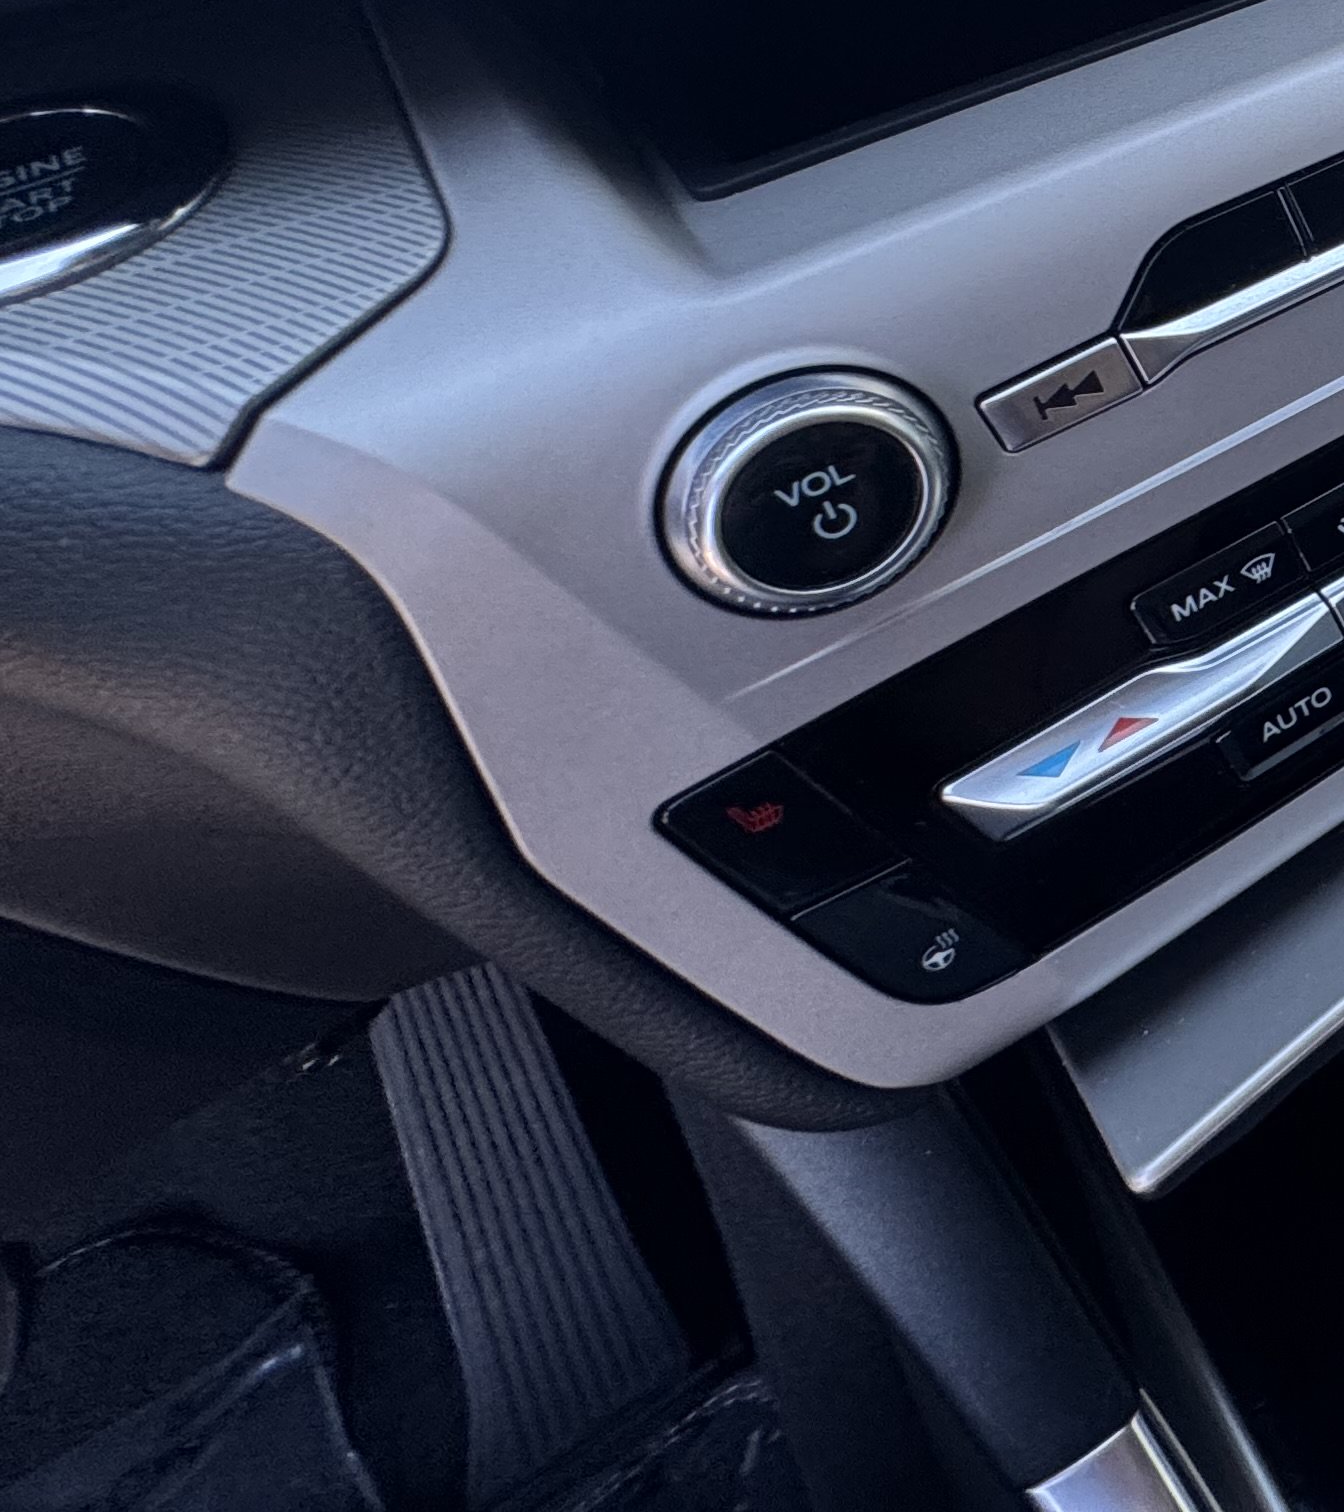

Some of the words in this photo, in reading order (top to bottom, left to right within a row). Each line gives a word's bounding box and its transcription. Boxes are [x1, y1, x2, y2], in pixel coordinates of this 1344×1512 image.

[774, 464, 858, 508] VOL
[1169, 574, 1236, 623] MAX
[1262, 686, 1333, 743] AUTO
